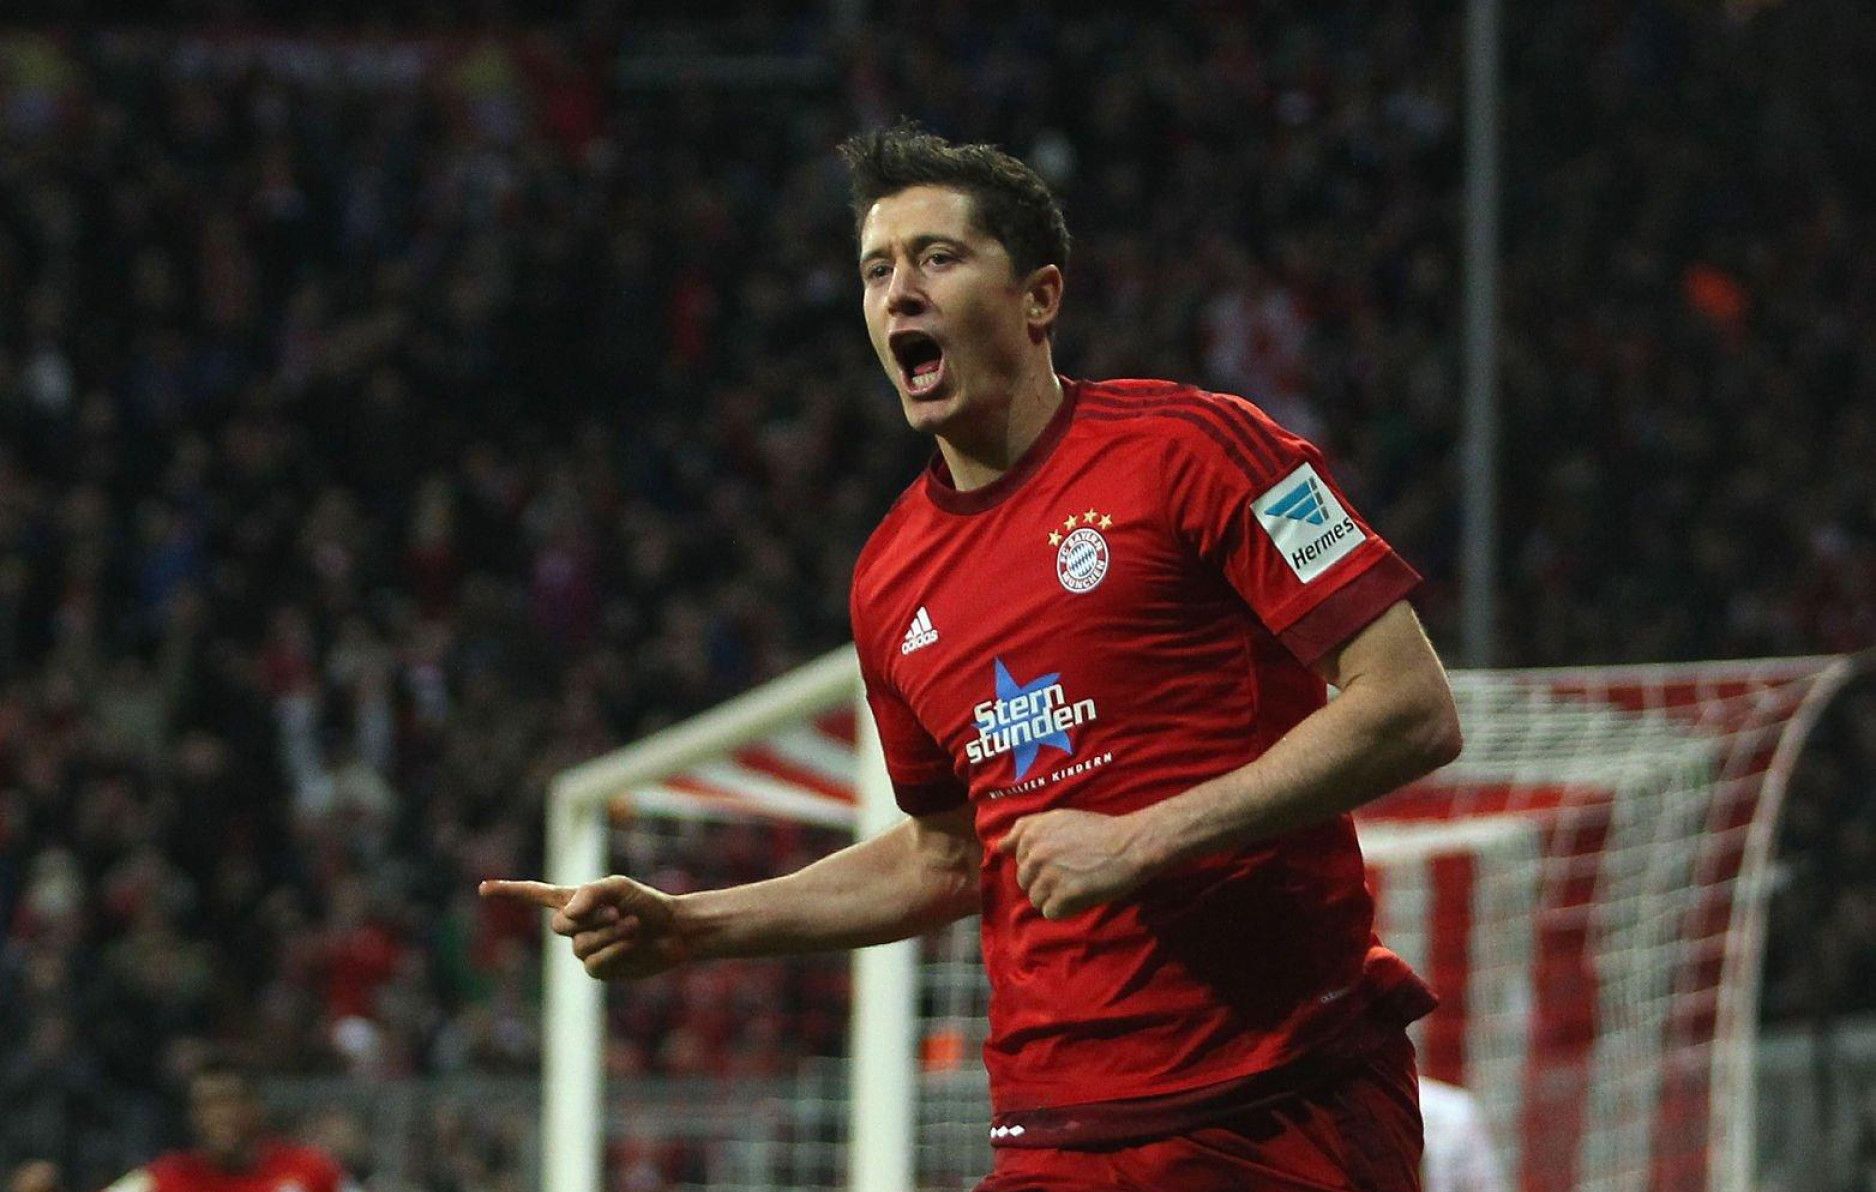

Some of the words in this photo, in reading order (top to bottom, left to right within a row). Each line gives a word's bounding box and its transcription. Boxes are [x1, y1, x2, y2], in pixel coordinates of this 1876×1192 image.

[1292, 517, 1354, 569] Hermes
[901, 629, 939, 655] adidas
[966, 698, 1096, 764] stunden
[974, 683, 1065, 732] Stern
[1051, 751, 1112, 782] KINDERN
